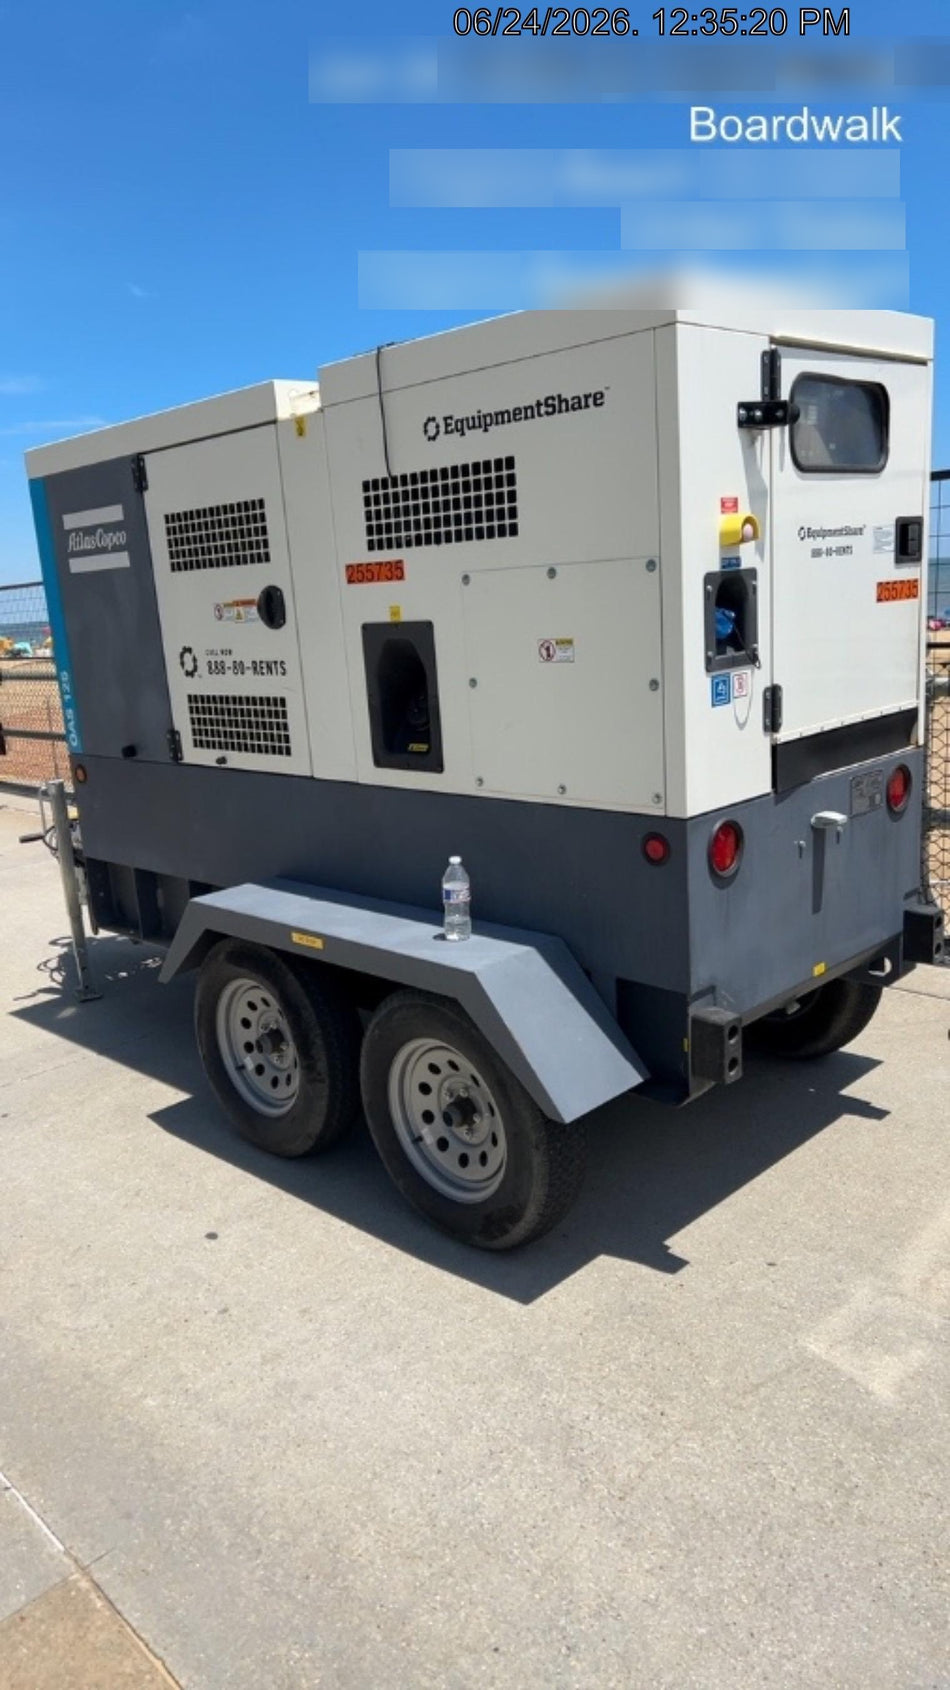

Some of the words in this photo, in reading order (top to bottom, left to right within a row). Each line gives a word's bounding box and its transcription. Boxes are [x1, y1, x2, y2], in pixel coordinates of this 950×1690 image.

[443, 391, 605, 437] EquipmentShare
[345, 560, 405, 584] 255735
[876, 579, 919, 603] 255735
[206, 660, 287, 677] 888-80-RENTS
